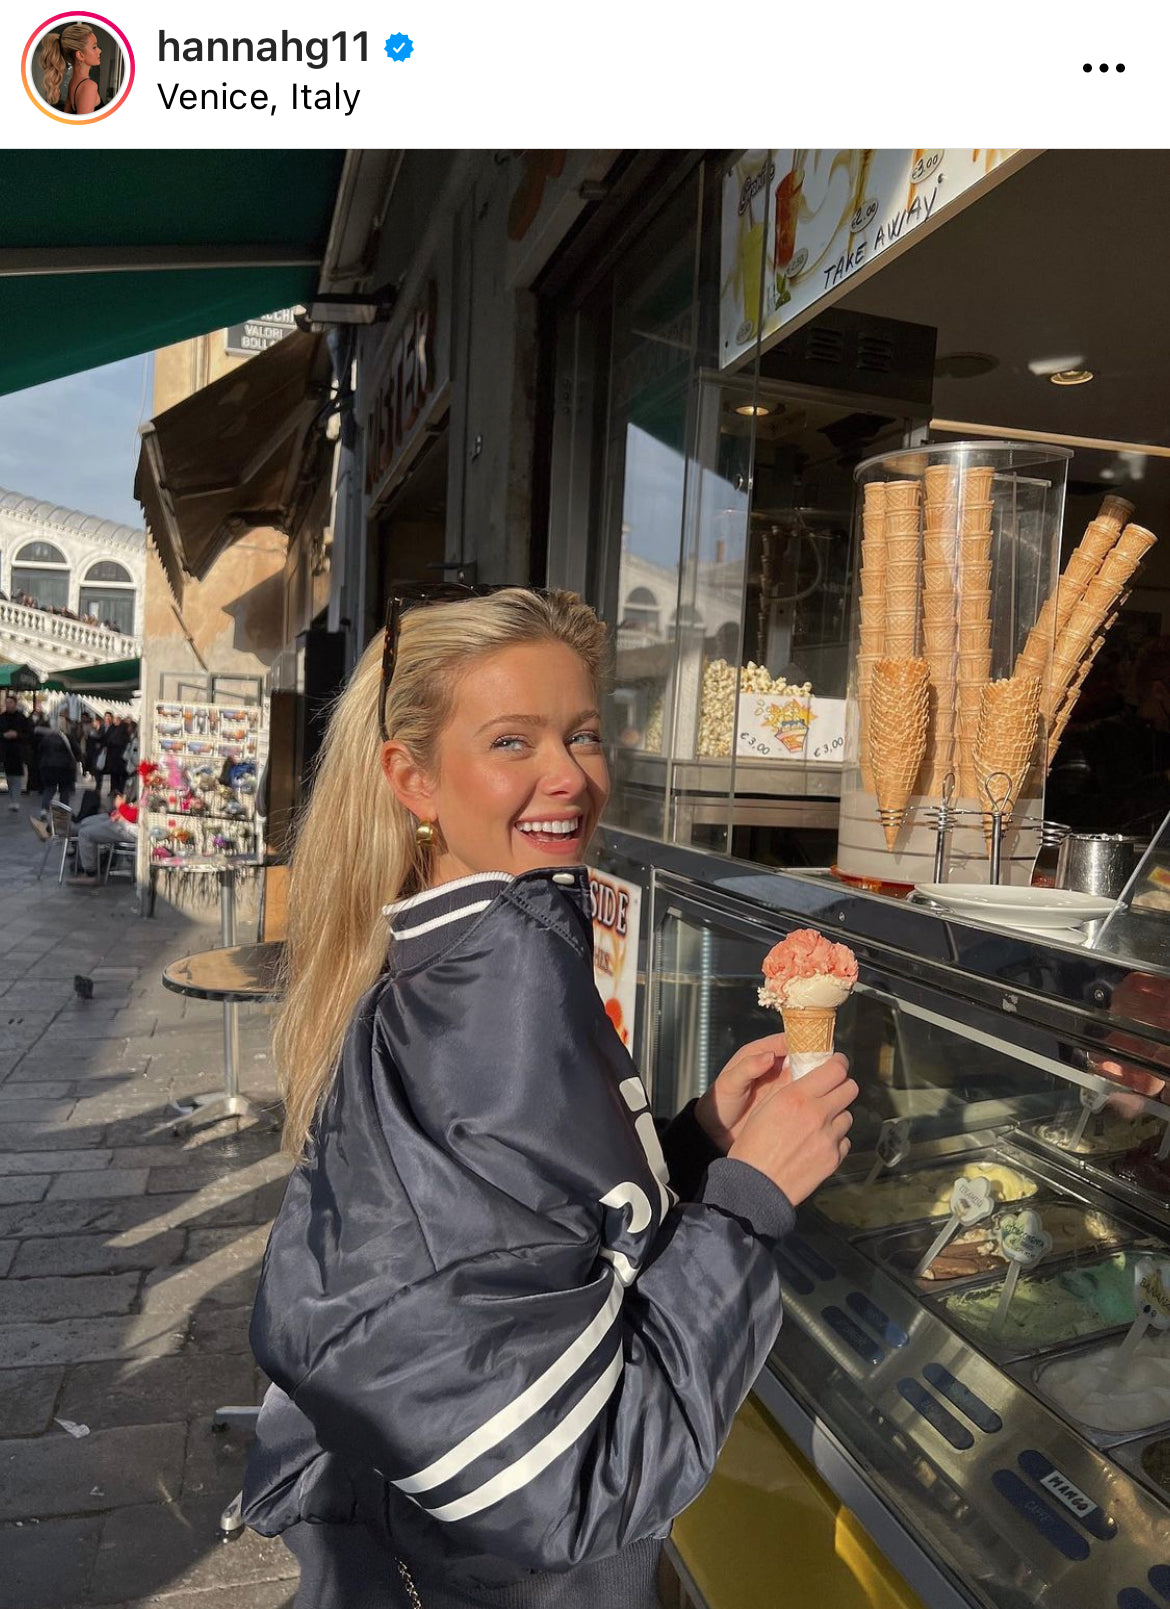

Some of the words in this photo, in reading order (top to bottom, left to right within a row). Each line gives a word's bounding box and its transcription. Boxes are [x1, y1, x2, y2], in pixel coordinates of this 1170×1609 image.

[823, 241, 868, 290] TAKE
[874, 186, 938, 250] AWAY
[244, 324, 283, 340] VALORI
[1046, 1475, 1089, 1512] MANGO
